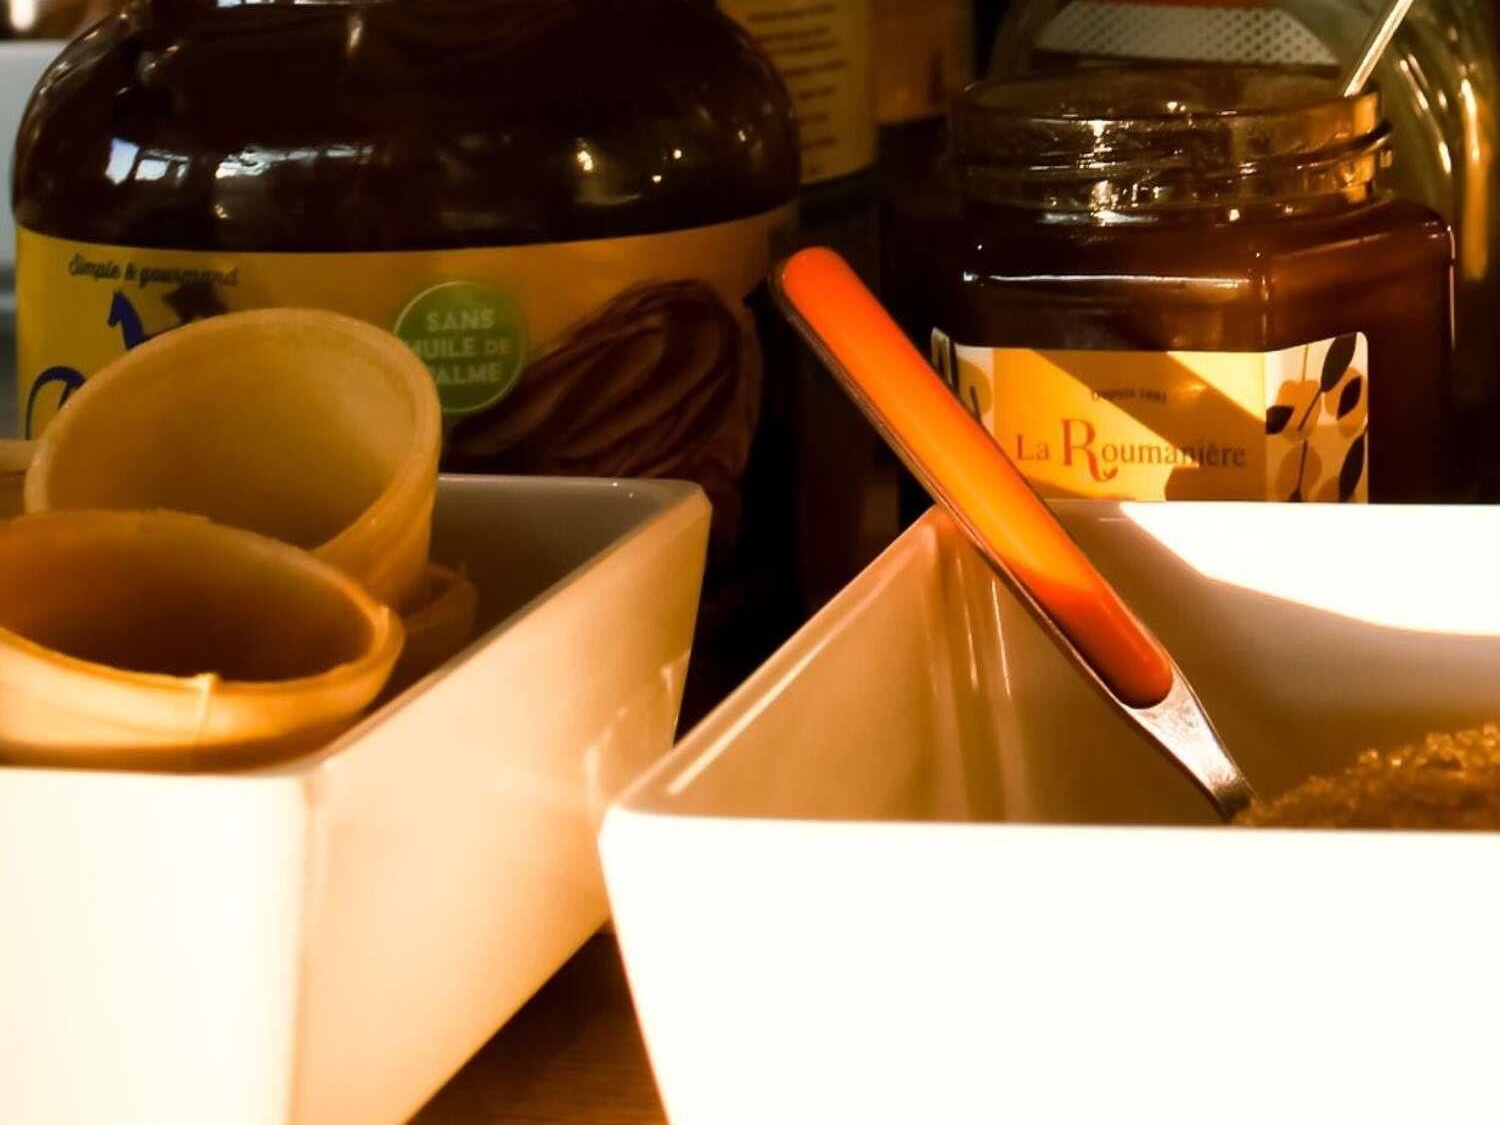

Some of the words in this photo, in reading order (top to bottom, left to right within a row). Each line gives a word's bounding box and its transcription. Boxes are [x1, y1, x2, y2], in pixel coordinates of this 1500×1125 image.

[426, 309, 494, 331] SANS
[485, 338, 511, 356] DE
[1016, 434, 1050, 461] La
[1060, 418, 1247, 482] Roumanière
